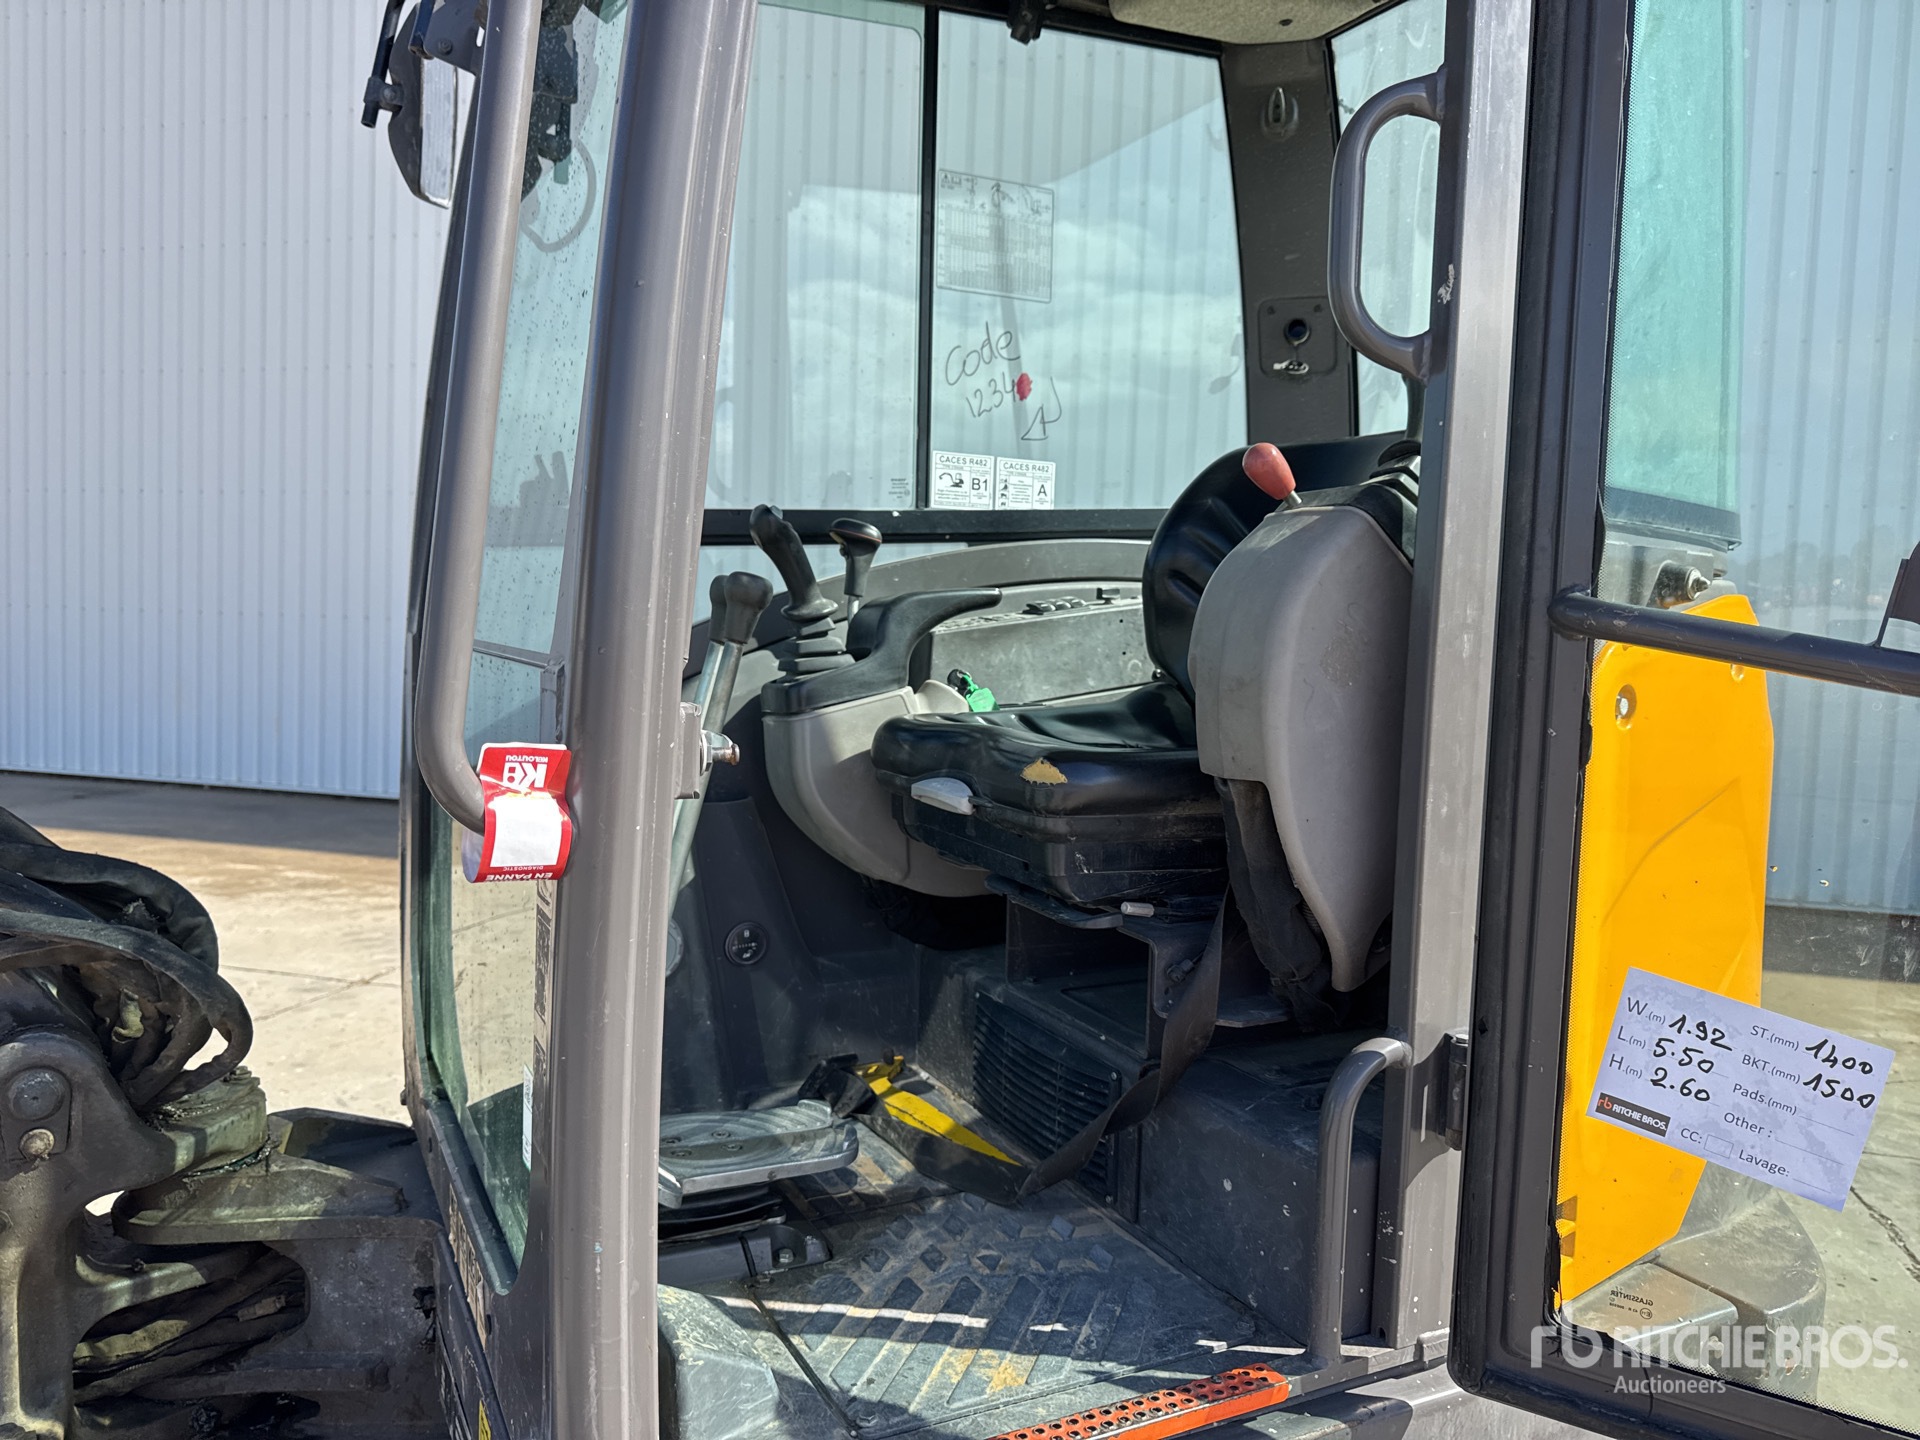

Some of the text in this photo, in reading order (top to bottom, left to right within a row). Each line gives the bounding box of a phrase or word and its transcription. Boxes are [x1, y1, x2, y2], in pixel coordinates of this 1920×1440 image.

[945, 321, 1021, 386] Code
[939, 455, 967, 465] CACES
[969, 458, 988, 467] R482
[1003, 462, 1050, 472] CACES R482
[971, 478, 988, 491] B1
[1037, 484, 1048, 497] A
[486, 873, 532, 881] PANNE
[1669, 1014, 1733, 1051] 1.92
[1653, 1037, 1714, 1074] 5.50
[1750, 1025, 1873, 1075] ST.(mm) 1400
[1650, 1067, 1711, 1101] 2.60
[1742, 1054, 1875, 1109] BKT.(mm) 1500
[1733, 1083, 1797, 1116] Pads.(mm)
[1612, 1103, 1643, 1121] RITCHIE
[1642, 1111, 1667, 1131] BROS.
[1723, 1112, 1765, 1135] Other
[1680, 1128, 1703, 1143] CC:
[1738, 1149, 1790, 1178] Lavage:
